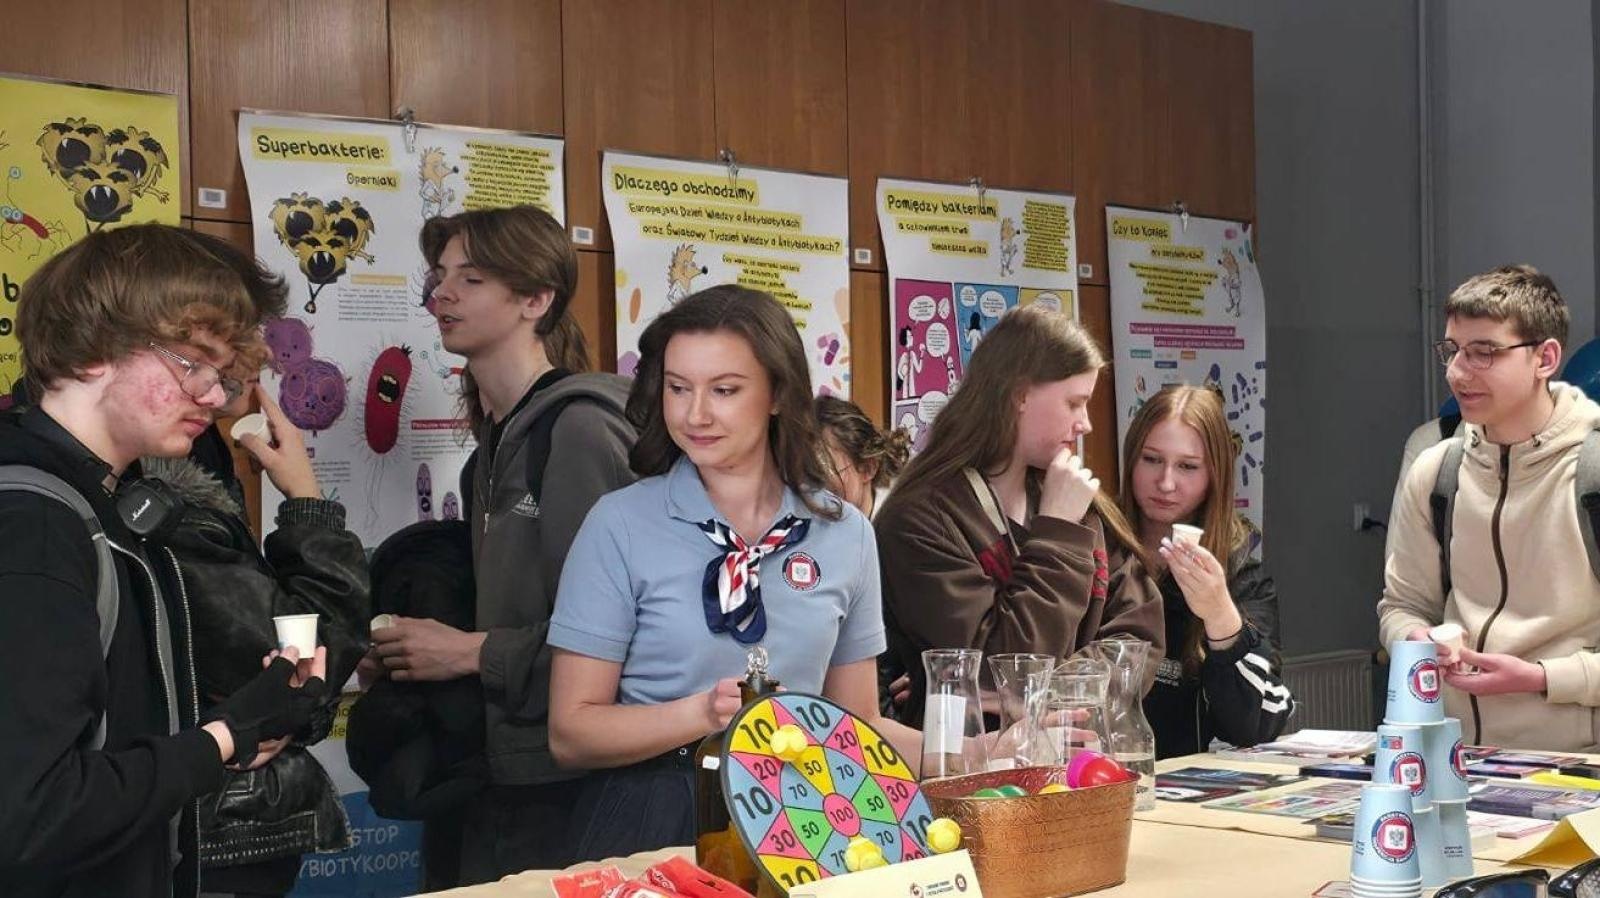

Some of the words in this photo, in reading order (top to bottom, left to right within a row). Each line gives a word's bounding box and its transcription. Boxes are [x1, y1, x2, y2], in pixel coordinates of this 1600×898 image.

[256, 134, 385, 160] Superbakterie:
[615, 172, 678, 196] Dlaczego
[682, 181, 756, 203] obchodzimy
[628, 202, 679, 217] Europejski
[705, 209, 734, 222] Wiedzy
[743, 211, 800, 228] Antybiotykach
[887, 194, 938, 214] Pomiędzy
[942, 201, 997, 217] bakteriami
[642, 224, 663, 235] oraz
[666, 222, 706, 241] Światowy
[709, 229, 740, 243] Tydzień
[741, 235, 770, 247] Wiedzy
[777, 234, 841, 252] Antybiotykach?
[1130, 225, 1140, 235] to
[795, 702, 830, 731] 10
[740, 718, 775, 750] 10
[834, 729, 857, 751] 20
[864, 740, 898, 770] 10
[753, 758, 778, 781] 20
[803, 759, 822, 776] 50
[836, 764, 855, 780] 70
[734, 786, 774, 820] 10
[788, 783, 808, 800] 70
[886, 782, 909, 802] 30
[829, 806, 854, 823] 100
[867, 795, 884, 812] 50
[350, 825, 399, 848] STOP
[770, 829, 796, 852] 30
[801, 821, 820, 839] 50
[876, 830, 894, 846] 70
